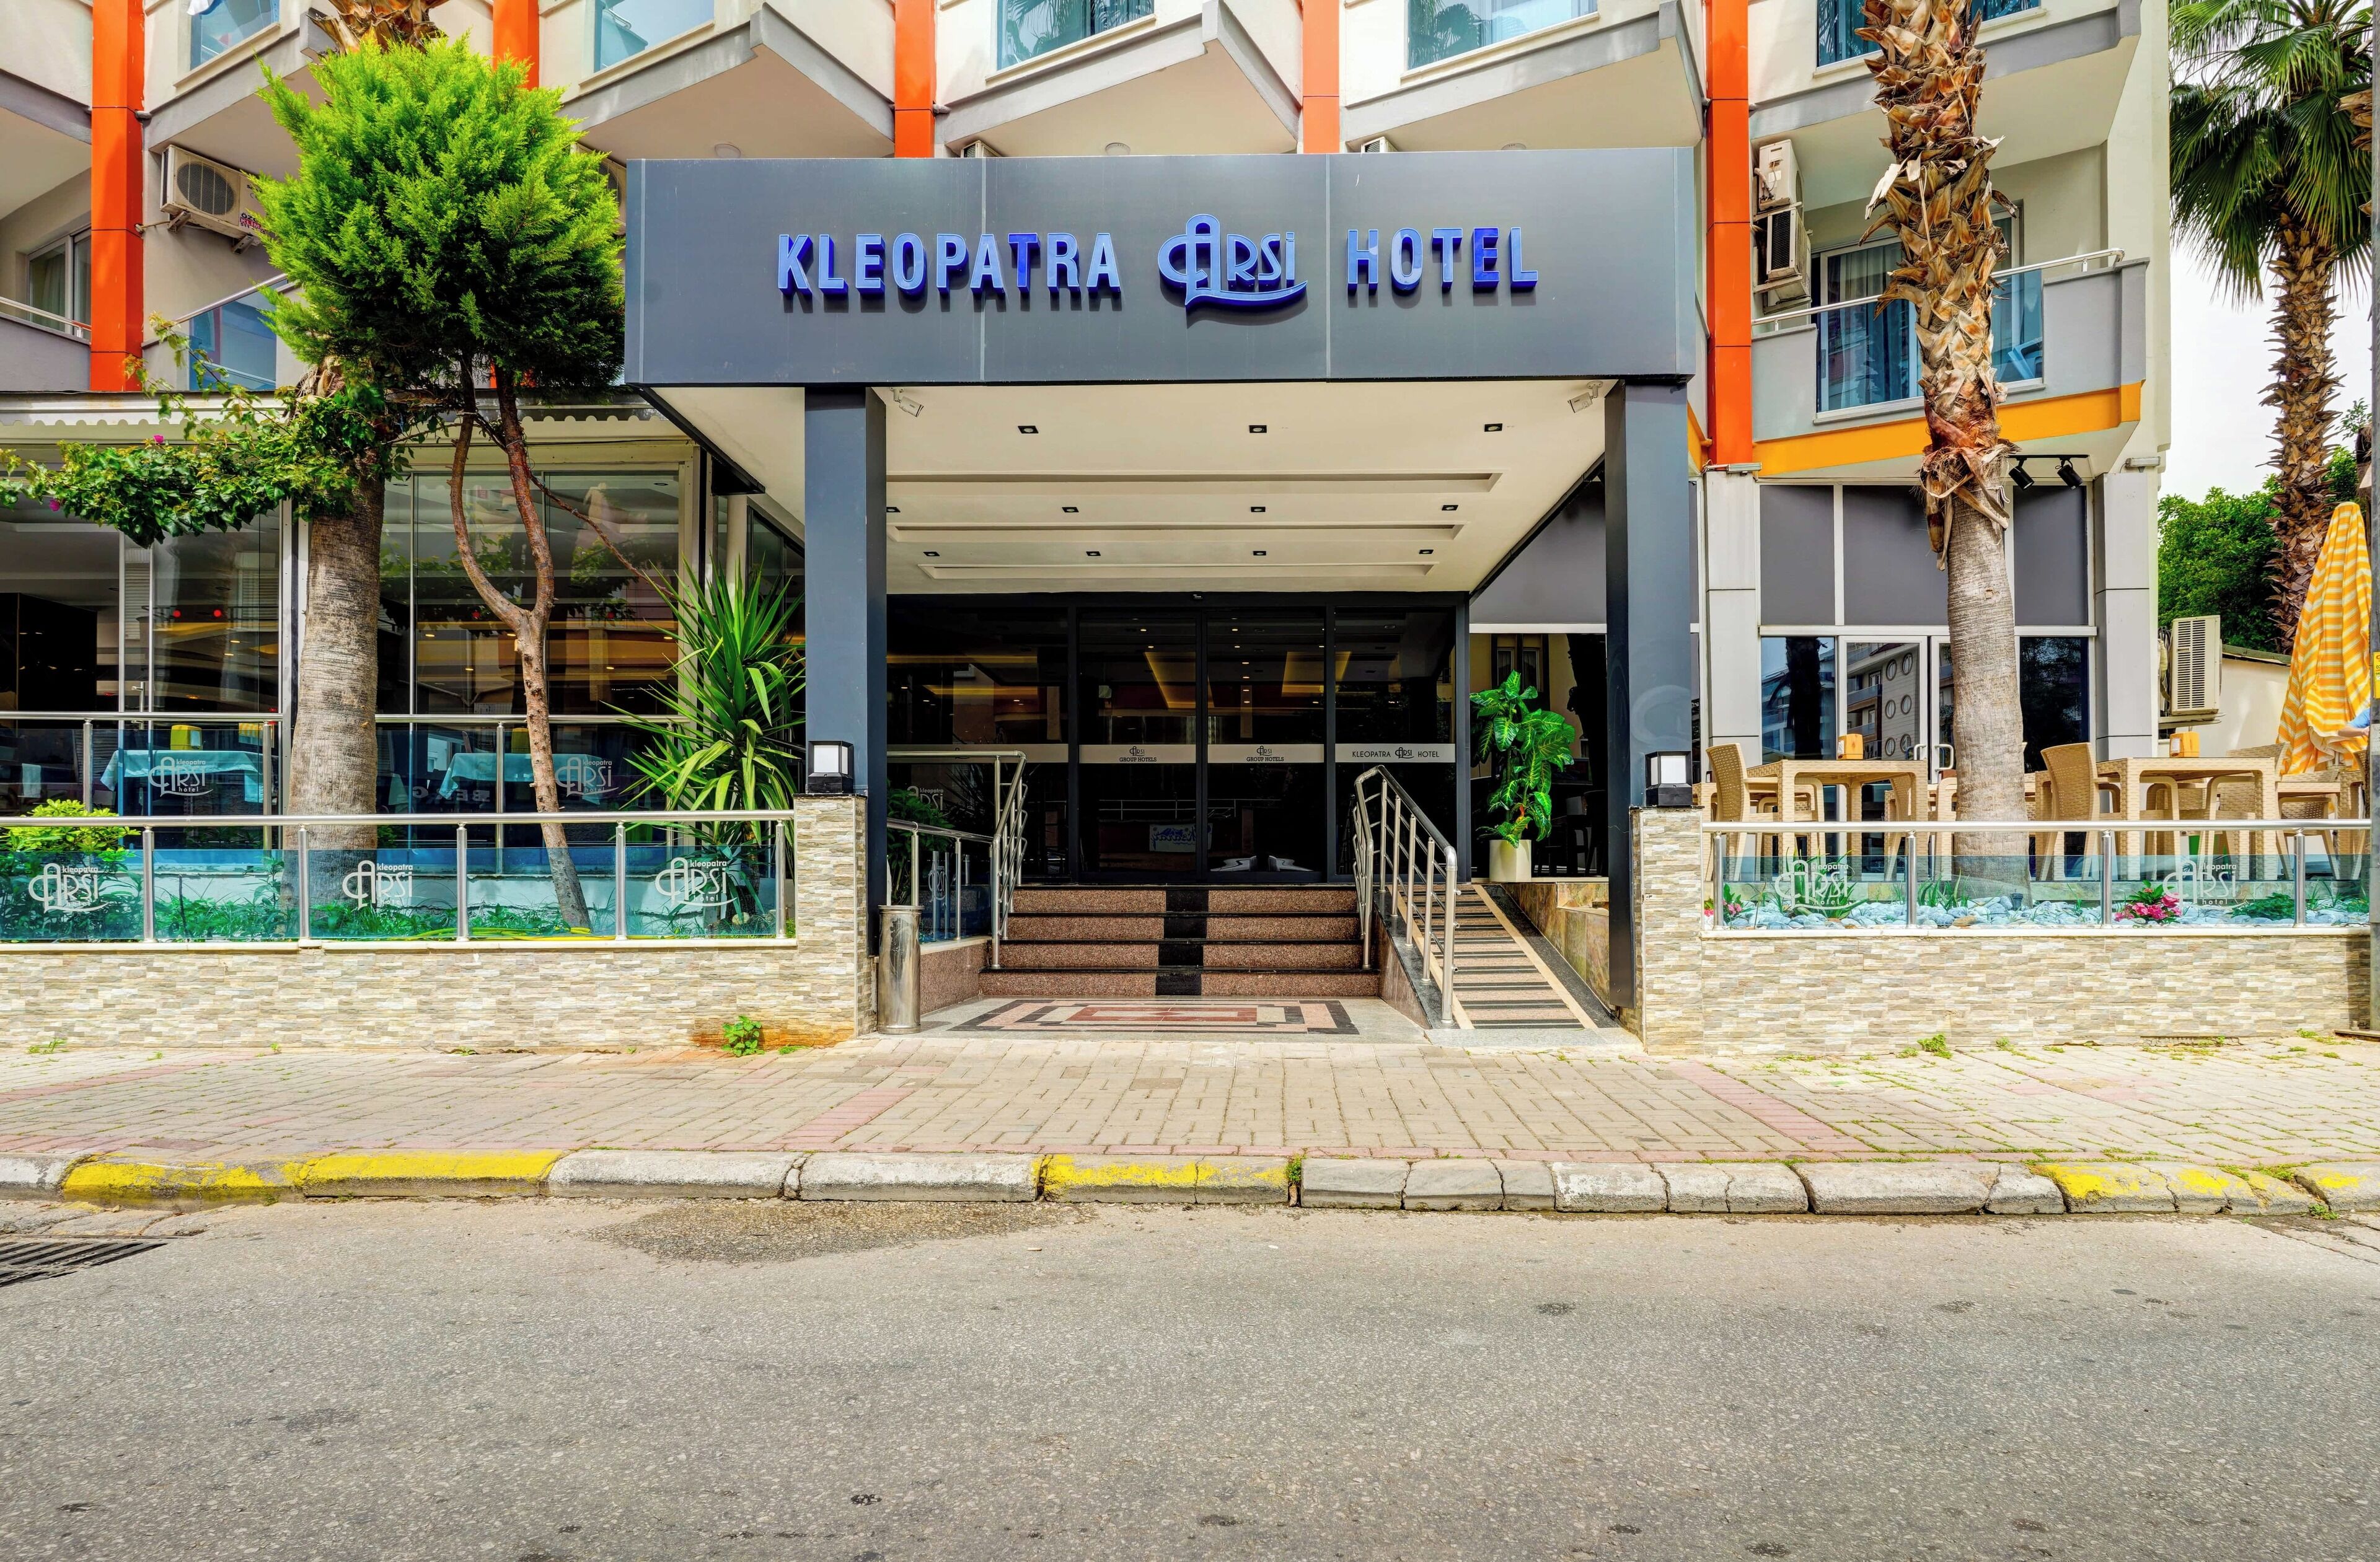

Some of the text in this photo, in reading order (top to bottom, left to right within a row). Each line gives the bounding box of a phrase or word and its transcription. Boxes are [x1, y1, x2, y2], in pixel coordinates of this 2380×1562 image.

[778, 233, 1122, 294] KLEOPATRA
[1347, 227, 1540, 290] HOTEL
[377, 862, 413, 872] kleopatra
[690, 859, 727, 868] kleopatra
[63, 866, 98, 874] kleopatra
